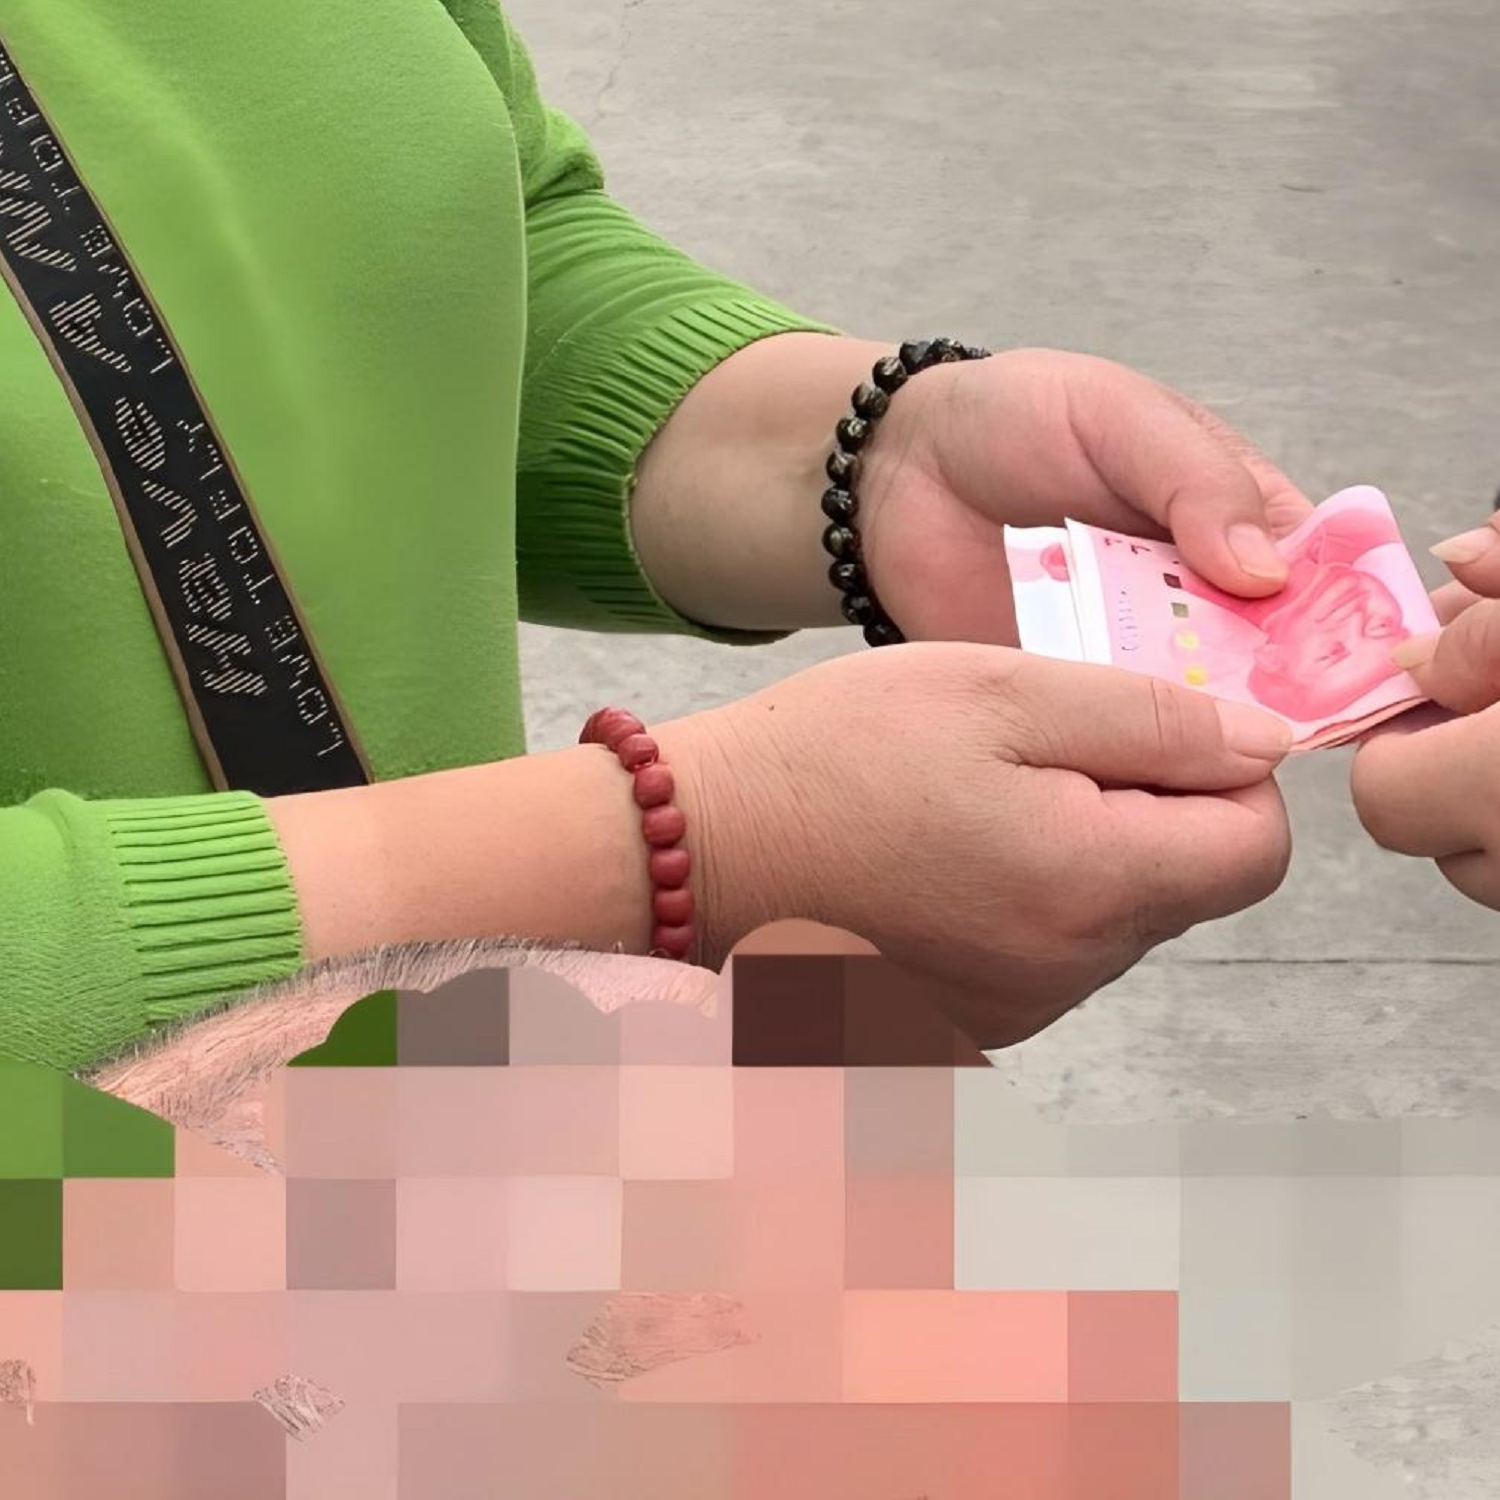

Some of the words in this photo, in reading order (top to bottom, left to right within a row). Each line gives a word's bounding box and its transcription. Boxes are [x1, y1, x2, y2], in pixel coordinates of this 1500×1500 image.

[50, 293, 131, 373] A
[80, 224, 174, 374] LOVE
[115, 397, 268, 696] Have
[264, 614, 344, 757] LOVE
